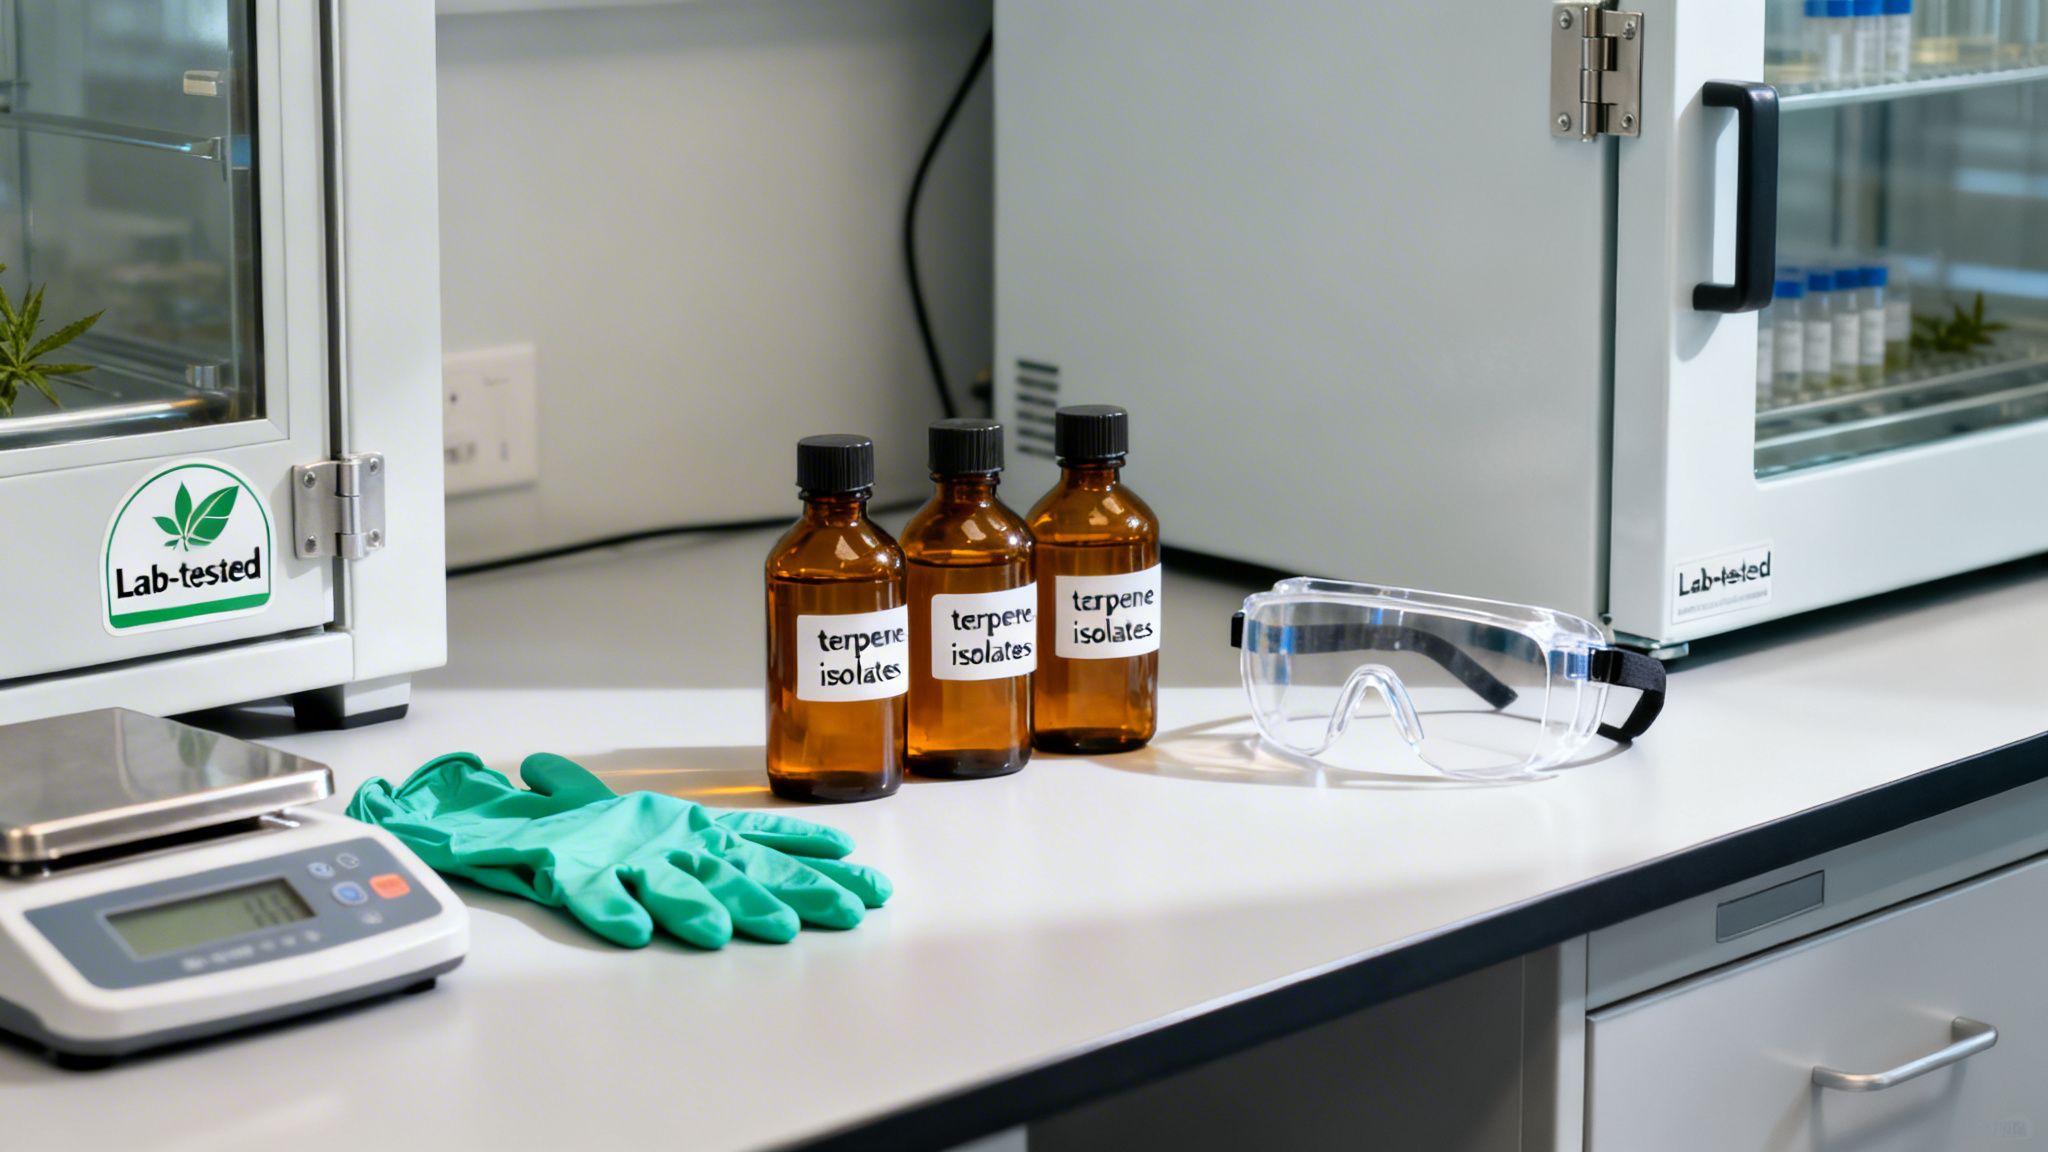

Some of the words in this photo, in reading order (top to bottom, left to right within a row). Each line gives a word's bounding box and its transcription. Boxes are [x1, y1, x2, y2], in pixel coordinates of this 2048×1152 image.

[116, 546, 262, 599] Lab-tested
[1072, 588, 1154, 616] terpene
[951, 606, 1035, 637] terpene
[1073, 618, 1153, 644] isolates
[951, 639, 1032, 667] isolates
[820, 657, 902, 687] isolates
